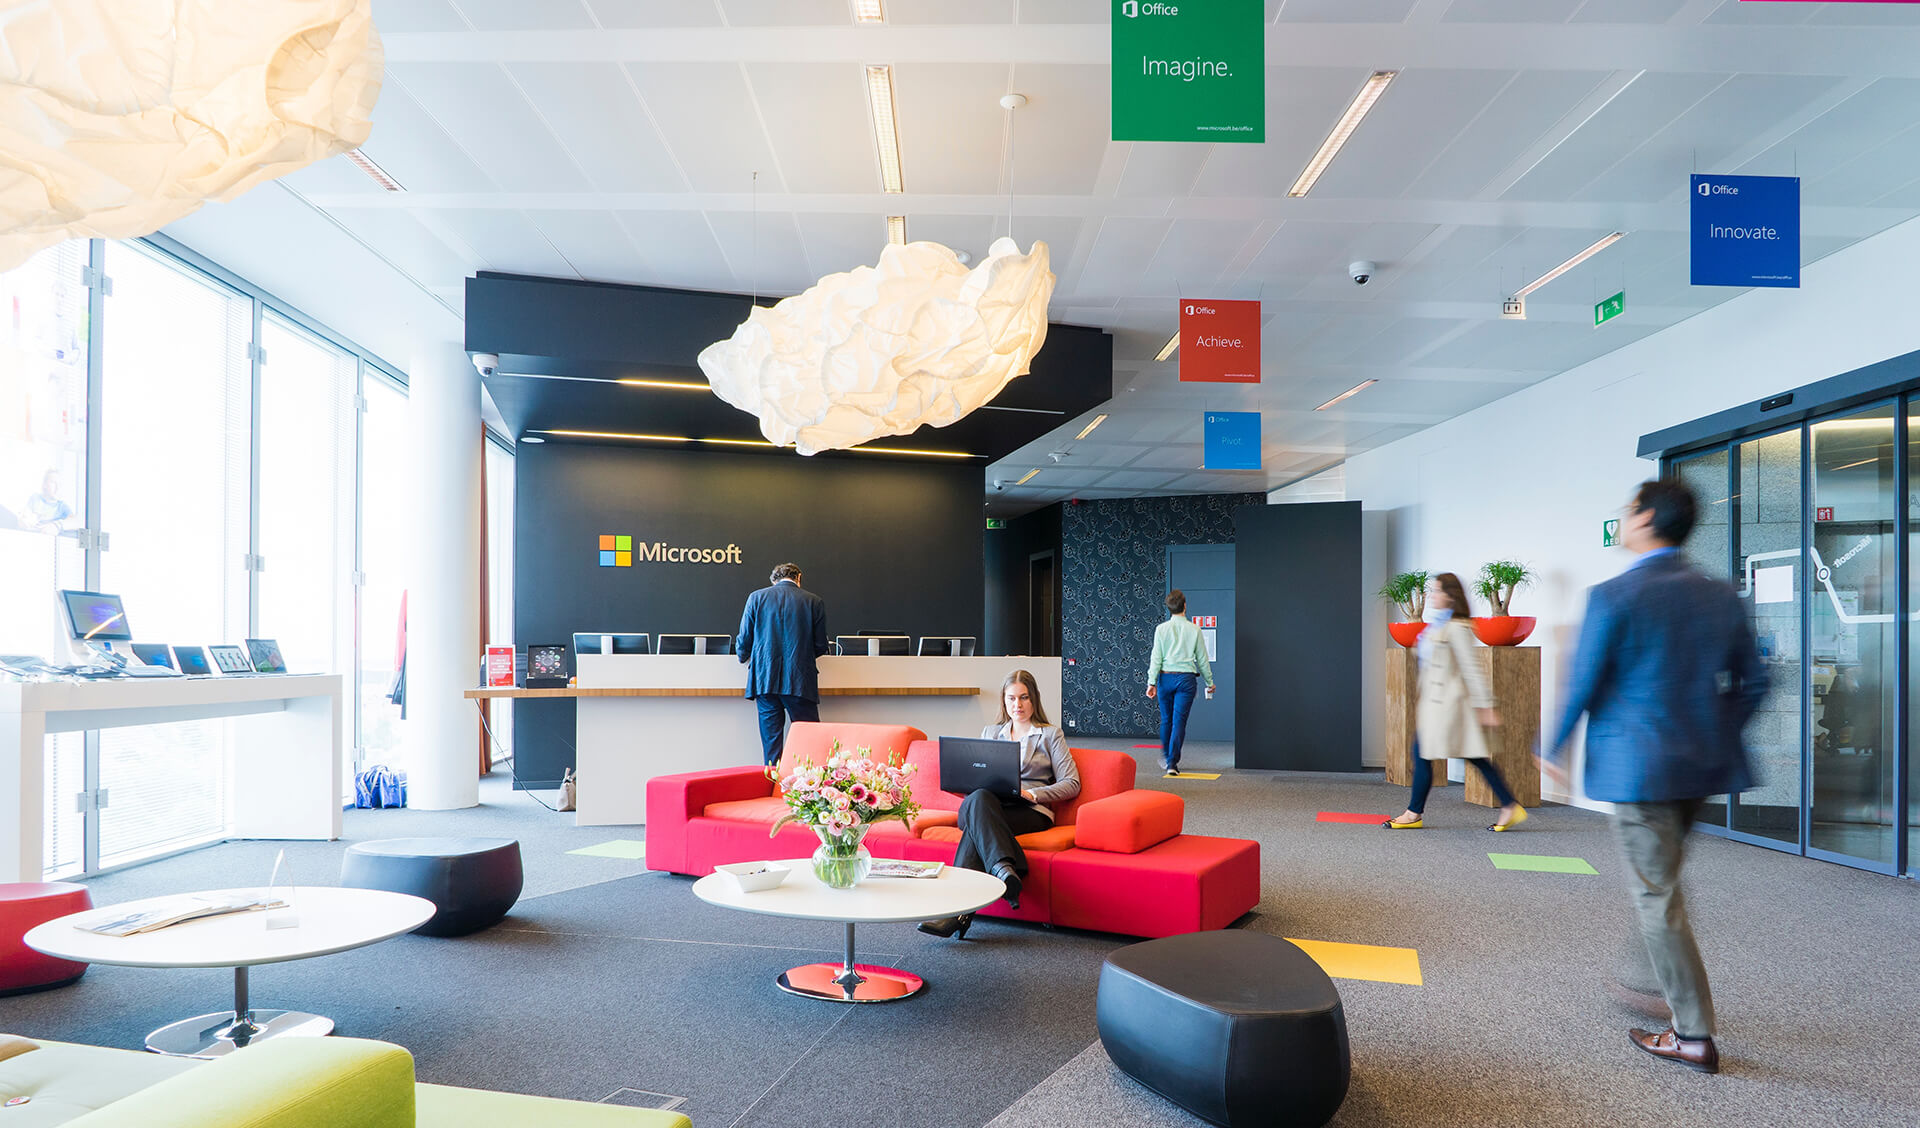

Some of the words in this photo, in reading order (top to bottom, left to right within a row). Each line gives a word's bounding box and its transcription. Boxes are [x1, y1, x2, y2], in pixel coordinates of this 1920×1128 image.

[1142, 3, 1178, 16] Office
[1143, 55, 1233, 82] Imagine.
[1712, 185, 1739, 195] Office
[1710, 223, 1780, 240] Innovate.
[1195, 307, 1216, 315] Office
[1195, 335, 1244, 348] Achieve.
[639, 542, 742, 564] Microsoft
